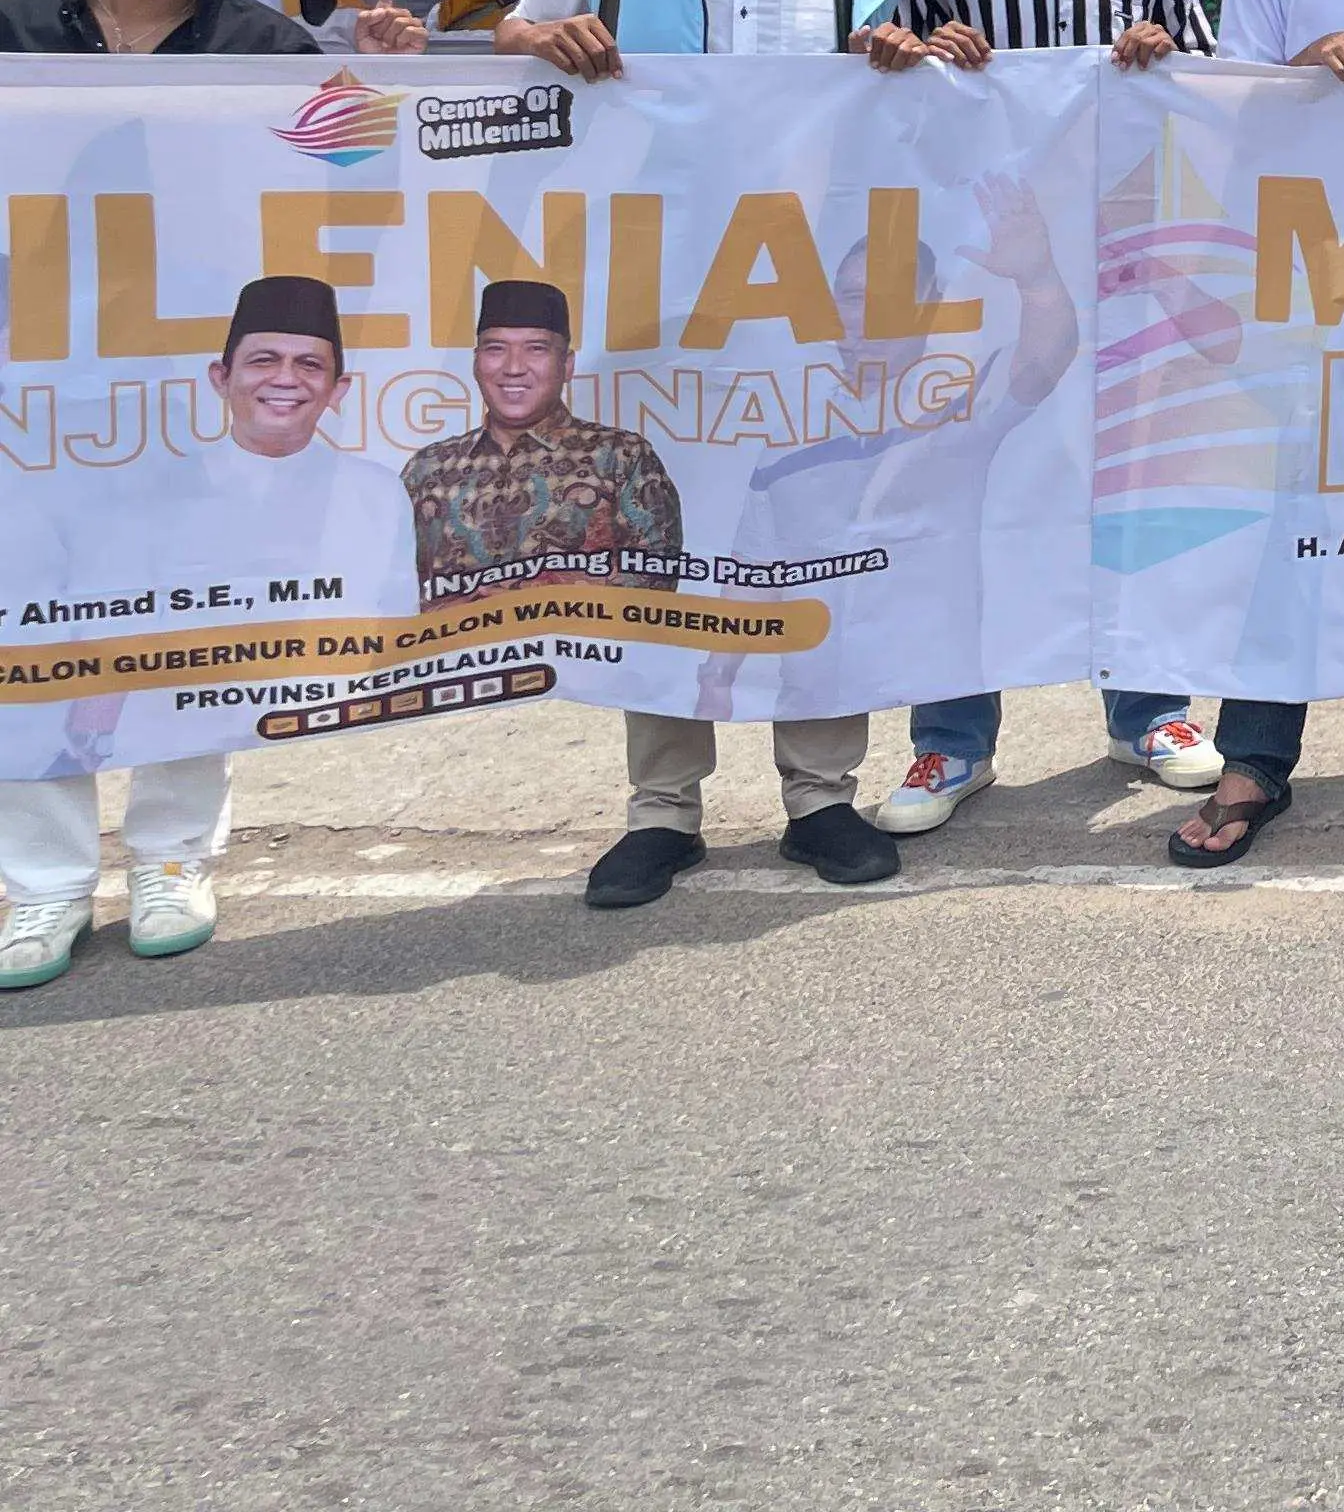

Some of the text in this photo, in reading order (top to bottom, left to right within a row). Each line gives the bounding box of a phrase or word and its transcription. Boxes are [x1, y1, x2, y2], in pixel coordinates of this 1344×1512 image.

[419, 86, 561, 123] Centre Of
[421, 113, 561, 152] Millenial
[1297, 537, 1327, 559] H.
[620, 550, 706, 580] Haris
[719, 550, 888, 588] Pratamura
[19, 590, 156, 626] Ahmad
[170, 584, 254, 611] S.E.,
[269, 576, 344, 602] M.M
[112, 637, 306, 675] GUBERNUR
[317, 634, 385, 658] DAN
[395, 608, 503, 649] CALON
[515, 600, 613, 622] WAKIL
[622, 603, 785, 637] GUBERNUR
[176, 639, 623, 711] PROVINSI KEPULAUAN RIAU
